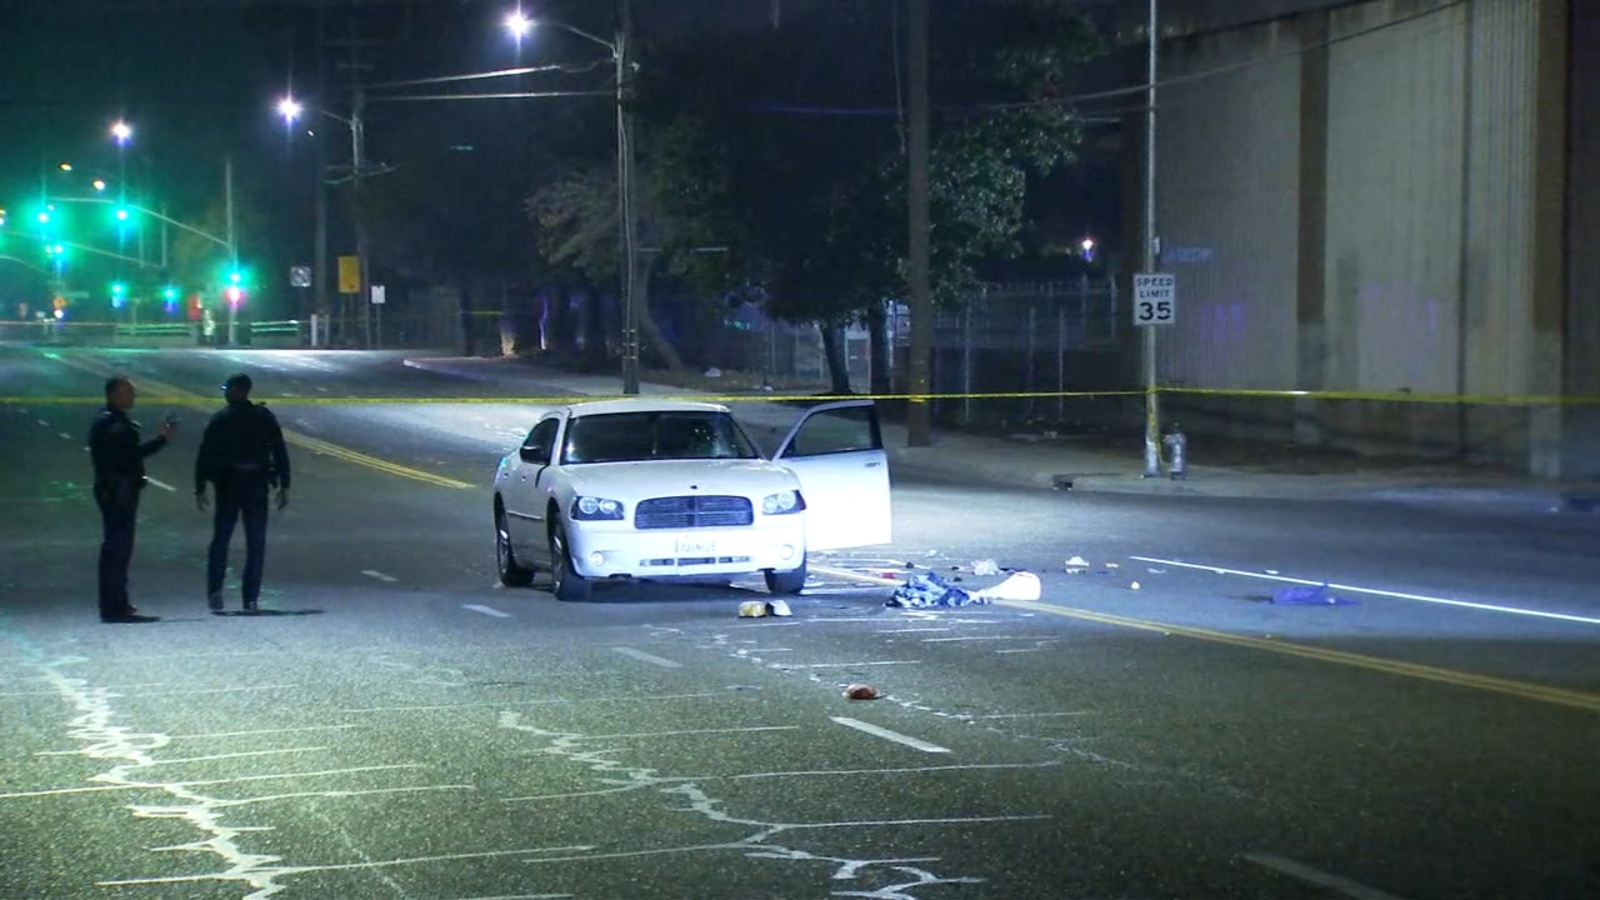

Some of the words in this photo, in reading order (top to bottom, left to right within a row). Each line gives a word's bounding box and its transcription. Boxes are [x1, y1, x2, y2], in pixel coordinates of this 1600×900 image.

[1136, 277, 1174, 287] SPEED
[1139, 289, 1170, 298] LIMIT
[1139, 301, 1171, 321] 35
